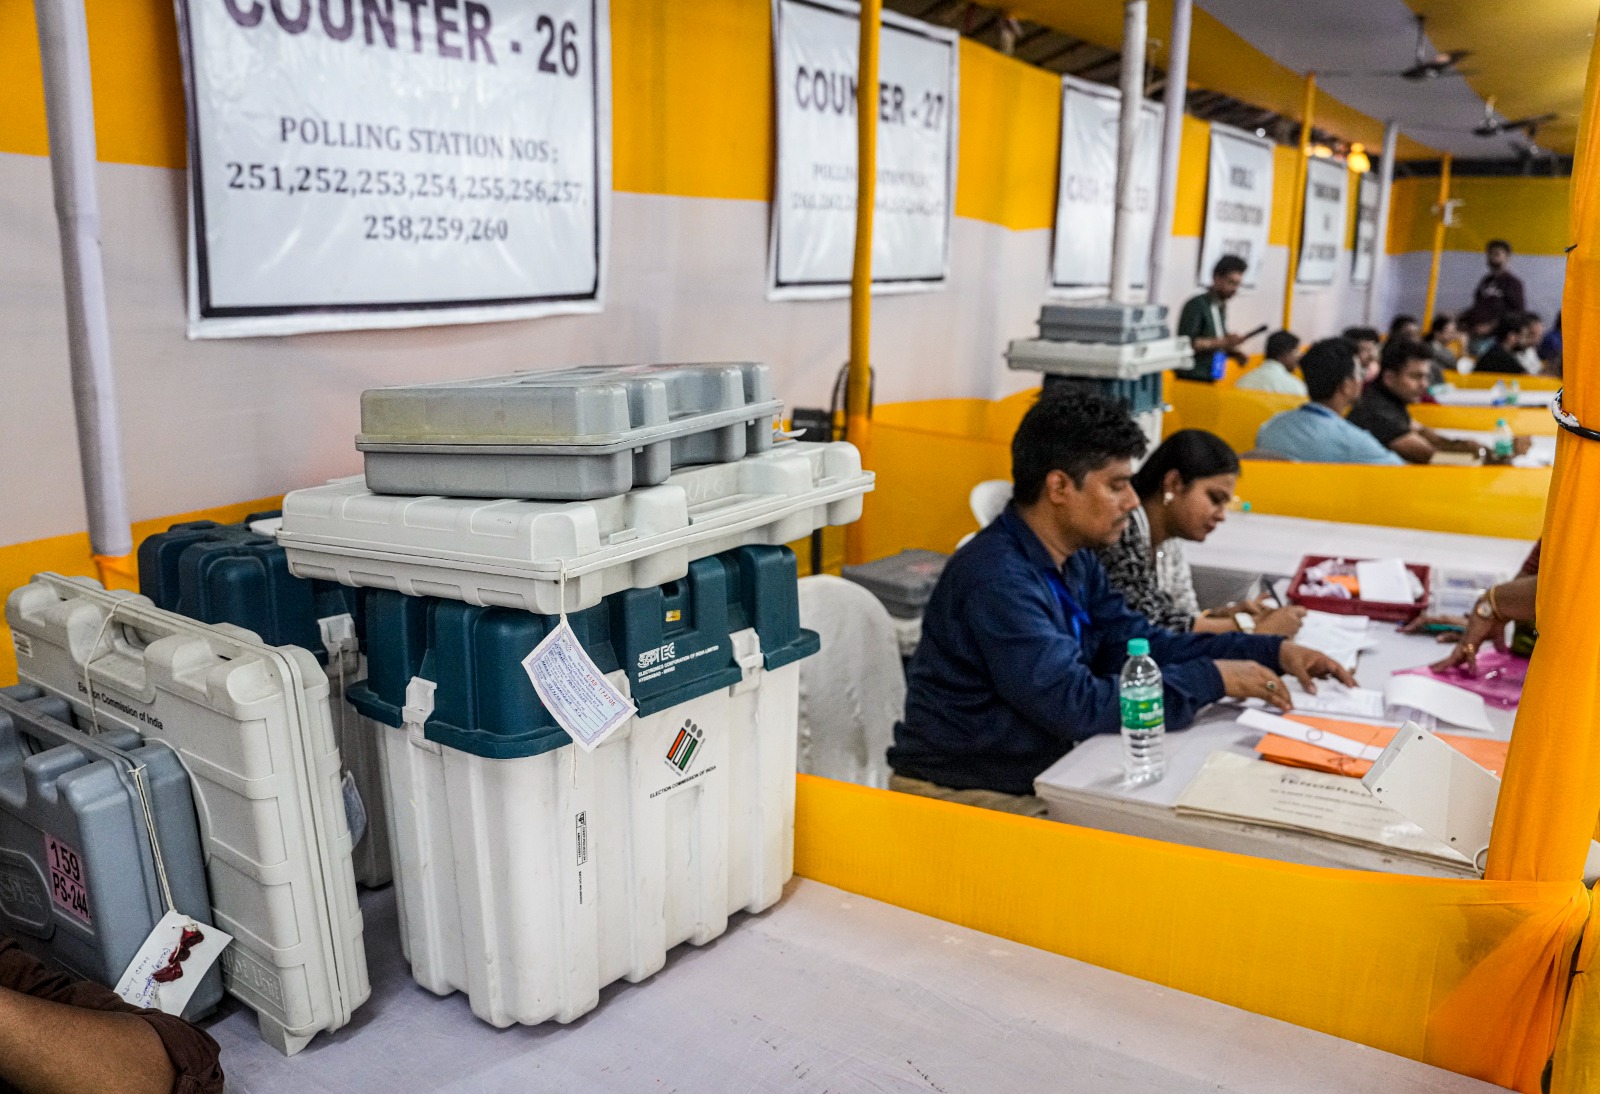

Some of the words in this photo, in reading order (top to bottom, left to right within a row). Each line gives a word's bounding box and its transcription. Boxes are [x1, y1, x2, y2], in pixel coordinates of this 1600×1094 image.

[536, 14, 579, 77] 26
[280, 116, 401, 151] POLLING
[408, 127, 504, 159] STATION
[364, 214, 509, 245] 258,259,260
[101, 692, 138, 719] Commission
[138, 711, 146, 722] of
[147, 713, 164, 731] India
[649, 785, 672, 799] ELECTION
[50, 840, 81, 882] 159
